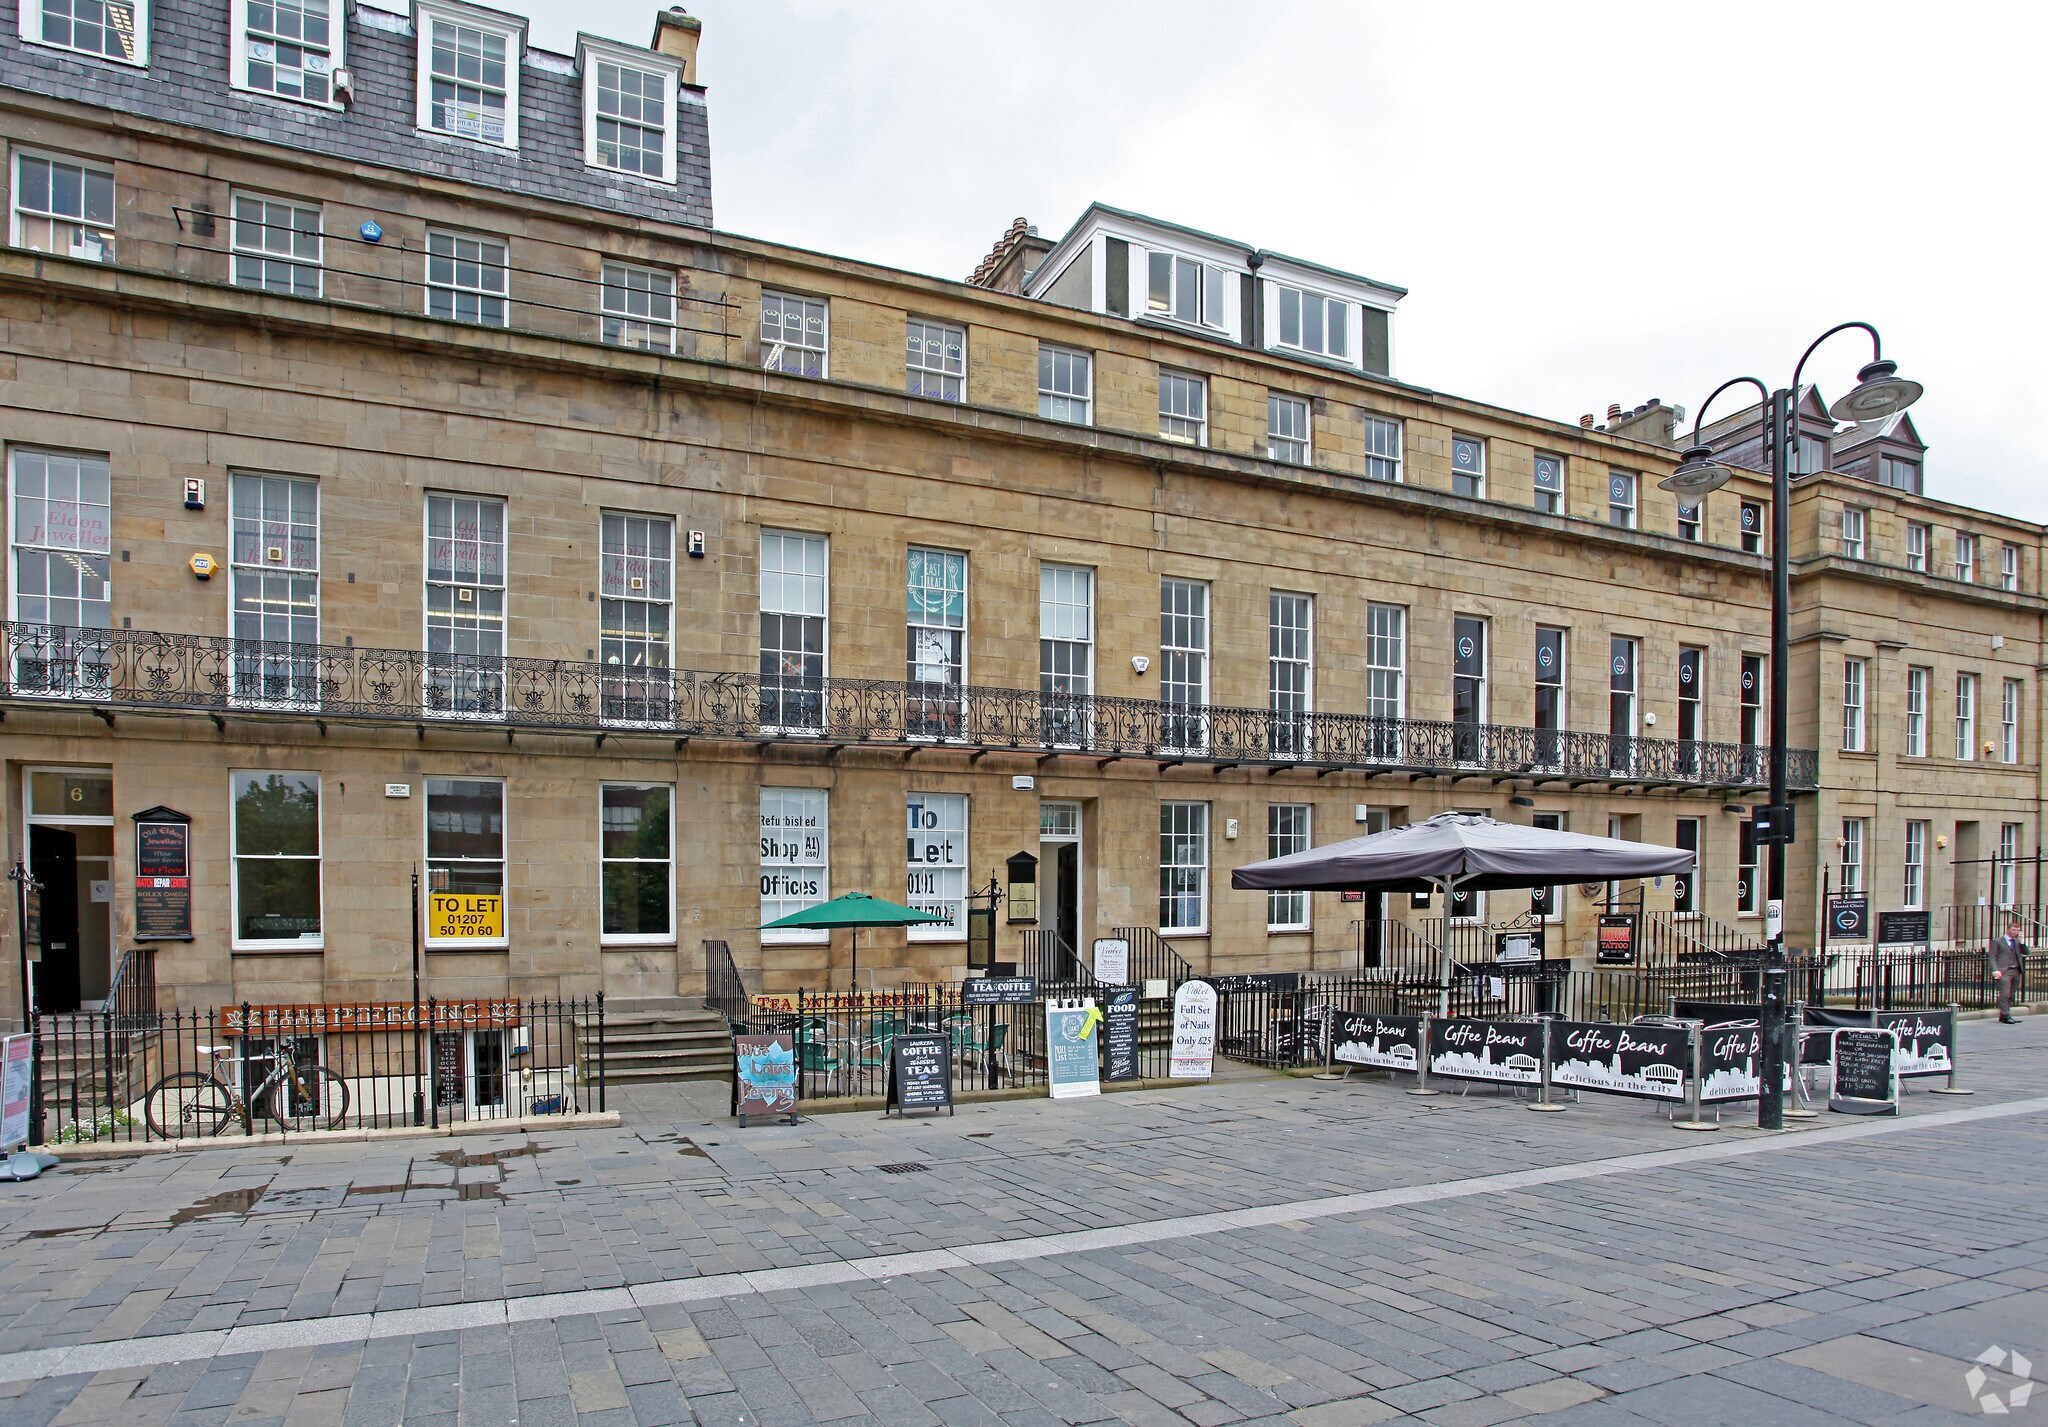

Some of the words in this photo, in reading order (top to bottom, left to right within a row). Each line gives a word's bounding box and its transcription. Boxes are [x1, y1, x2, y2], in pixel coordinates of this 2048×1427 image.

[48, 512, 102, 529] Eldon
[29, 526, 109, 546] Jeweller
[195, 560, 208, 568] ADT
[920, 576, 945, 590] TRRAC
[71, 788, 83, 801] 6
[761, 815, 816, 826] Refubised
[907, 804, 938, 829] To
[761, 838, 799, 862] Shop
[908, 838, 953, 863] Let
[154, 878, 170, 888] REPAIR
[761, 875, 817, 895] Offices
[908, 873, 934, 894] 0191
[434, 898, 459, 912] TO
[466, 899, 498, 912] LET
[448, 914, 485, 924] 01207
[440, 926, 455, 935] 50
[459, 926, 474, 935] 70
[478, 926, 492, 935] 60
[972, 983, 993, 992] TEA
[998, 983, 1031, 991] COFFEE
[1183, 983, 1208, 995] Violet
[757, 997, 792, 1011] TEA
[1108, 1004, 1136, 1013] FOOD
[1180, 1005, 1196, 1014] Full
[1198, 1005, 1210, 1014] Set
[333, 1004, 482, 1026] PIERCING
[1180, 1021, 1188, 1029] of
[1190, 1021, 1210, 1029] Nails
[1344, 1018, 1373, 1036] Coffee
[1376, 1018, 1406, 1037] Beans
[1888, 1019, 1912, 1041] Cffee
[1914, 1017, 1942, 1038] Beans
[1177, 1036, 1196, 1045] Only
[1198, 1036, 1211, 1045] £25
[1444, 1024, 1482, 1046] Coffee
[1485, 1025, 1526, 1047] Beans
[1567, 1029, 1612, 1053] Coffee
[1616, 1030, 1668, 1055] Beans
[737, 1043, 770, 1056] Blue
[902, 1046, 942, 1056] COFFEE
[1713, 1034, 1747, 1061] Coffee
[1341, 1053, 1372, 1063] delicious
[751, 1059, 791, 1077] Lotus
[905, 1065, 939, 1075] TEAS
[1440, 1065, 1480, 1075] delicious
[1513, 1071, 1532, 1081] city
[1562, 1073, 1610, 1086] delicious
[1627, 1081, 1646, 1090] the
[1651, 1084, 1672, 1096] city
[1710, 1087, 1745, 1096] delicious
[738, 1079, 795, 1112] Piercing
